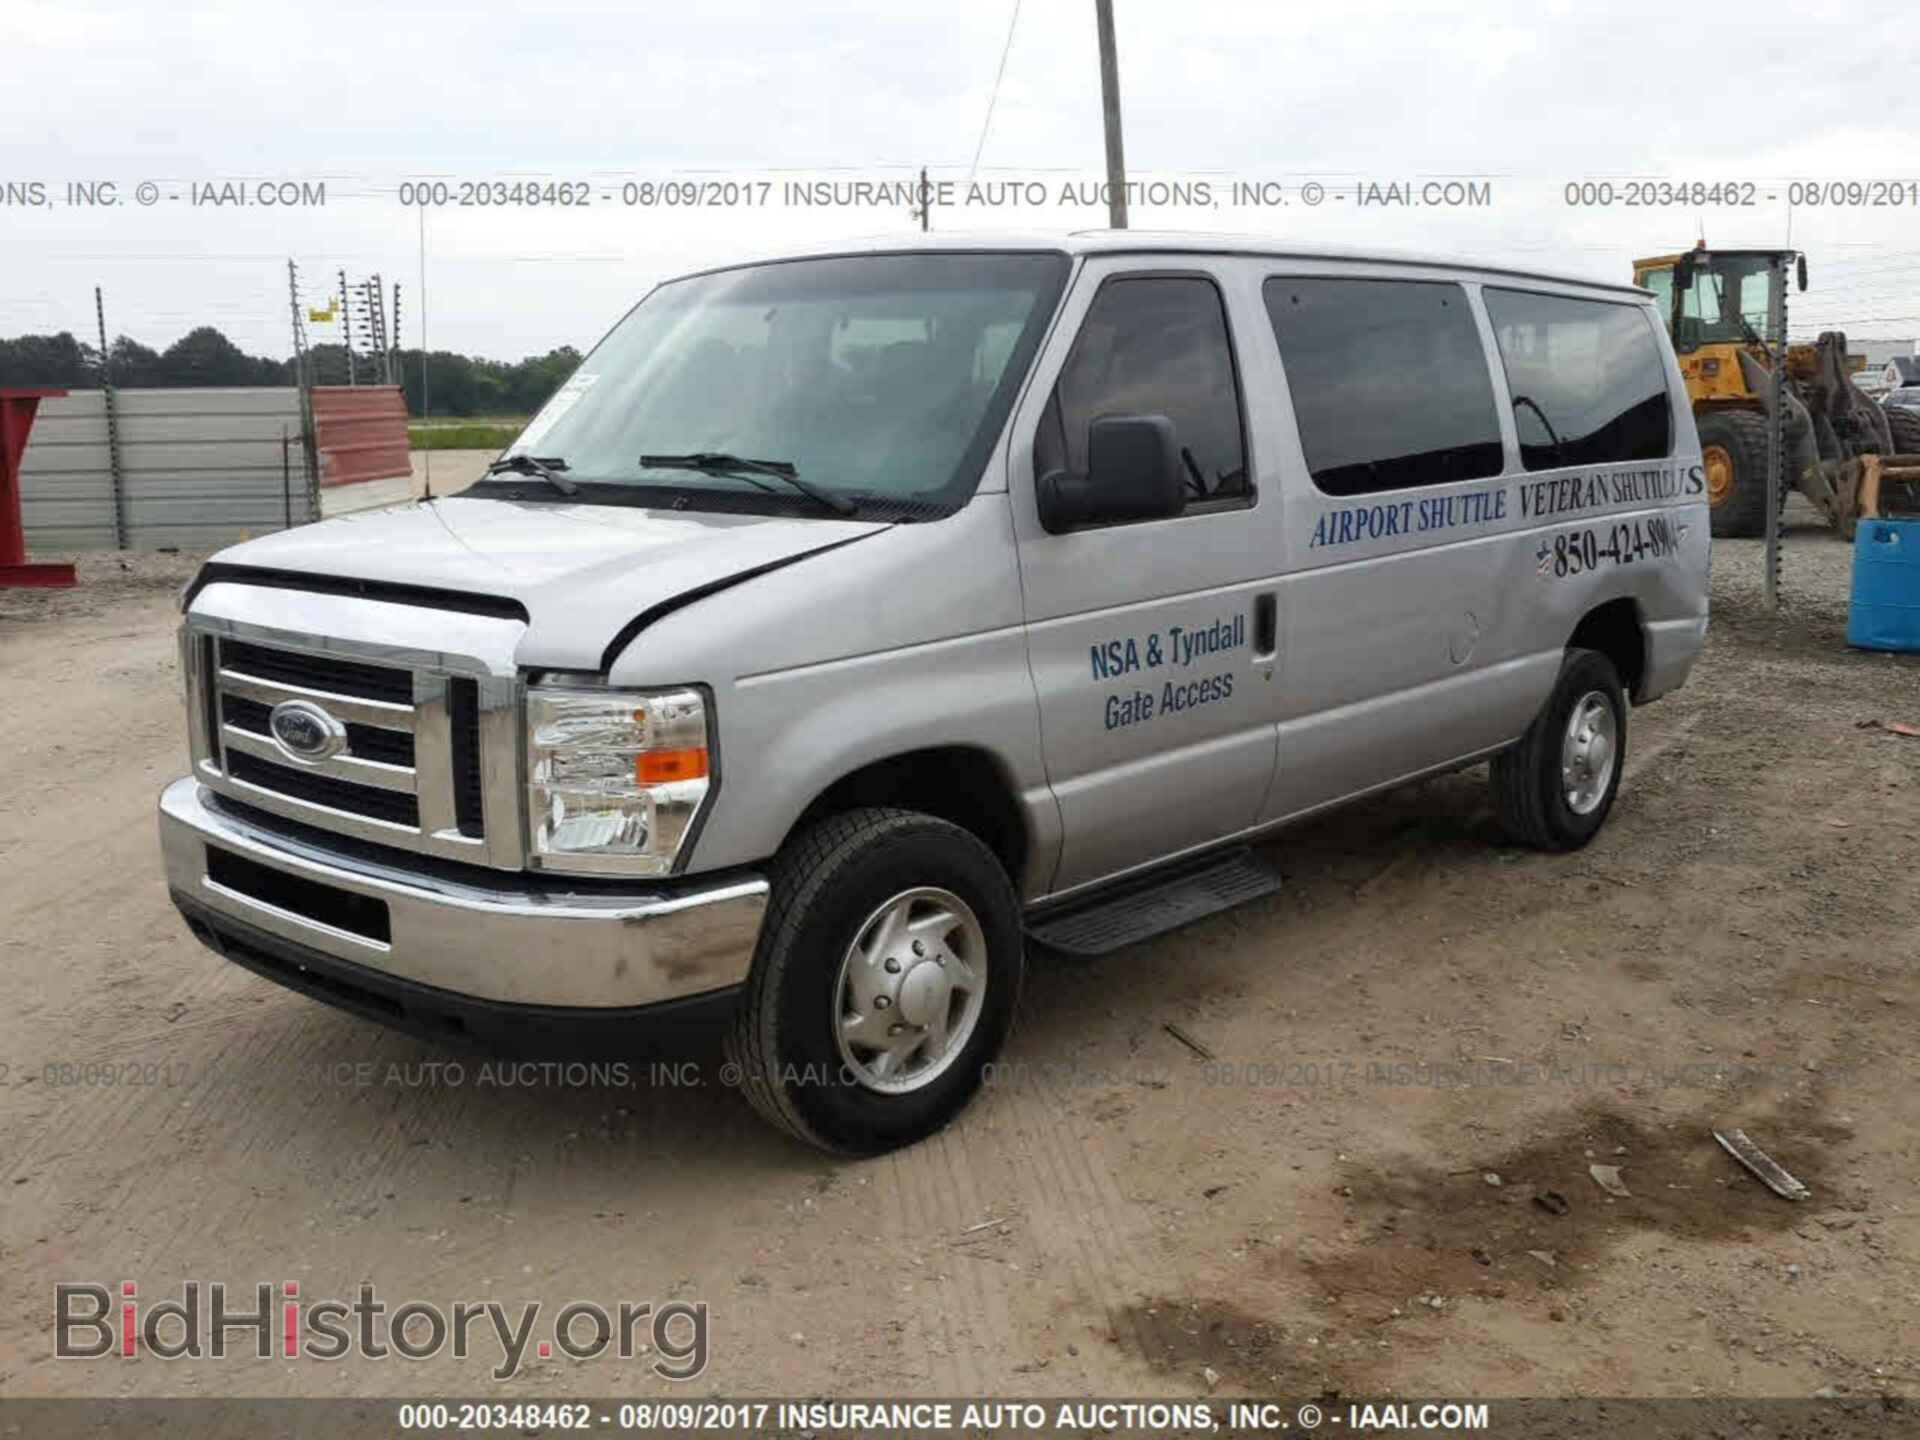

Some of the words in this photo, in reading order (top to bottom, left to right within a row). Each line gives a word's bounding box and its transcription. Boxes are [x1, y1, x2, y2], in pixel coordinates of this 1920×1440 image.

[1310, 502, 1413, 548] AIRPORT
[1418, 489, 1506, 530] SHUTTLE
[1520, 473, 1609, 517] VETERAN
[1091, 638, 1140, 680] NSA
[1146, 634, 1163, 667] &
[1170, 614, 1244, 666] Tyndall
[1105, 691, 1153, 730] Gate
[1160, 672, 1233, 715] Access
